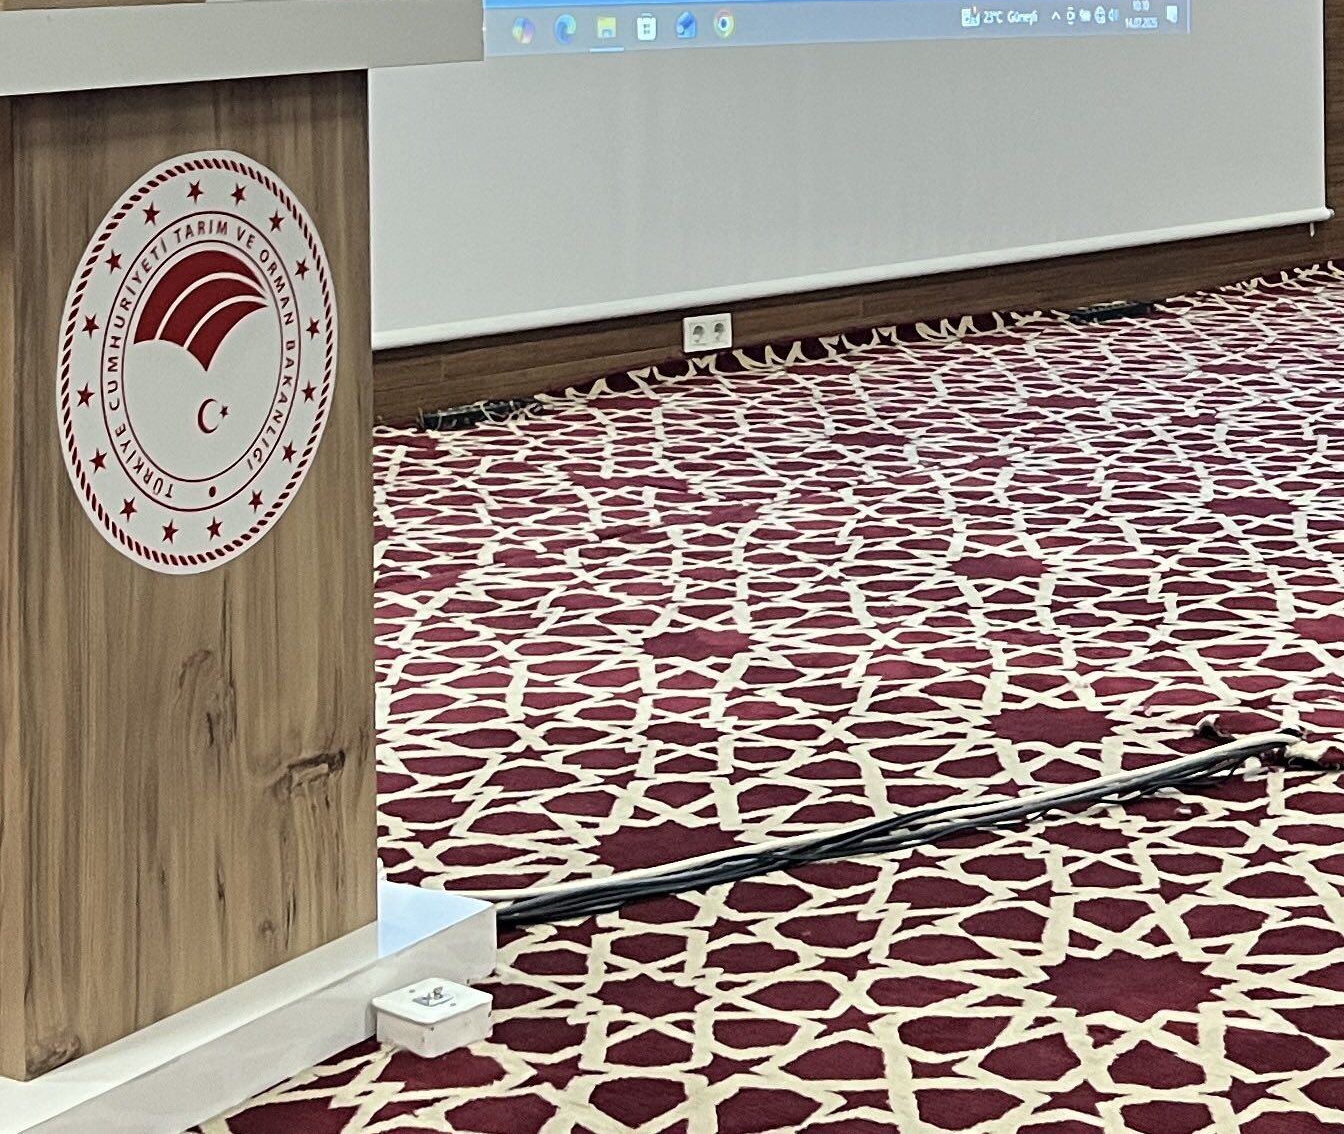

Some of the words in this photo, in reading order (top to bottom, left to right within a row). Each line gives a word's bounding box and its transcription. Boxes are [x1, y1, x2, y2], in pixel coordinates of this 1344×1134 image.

[173, 219, 229, 244] TARIM
[236, 226, 256, 250] VE
[258, 249, 295, 326] ORMAN
